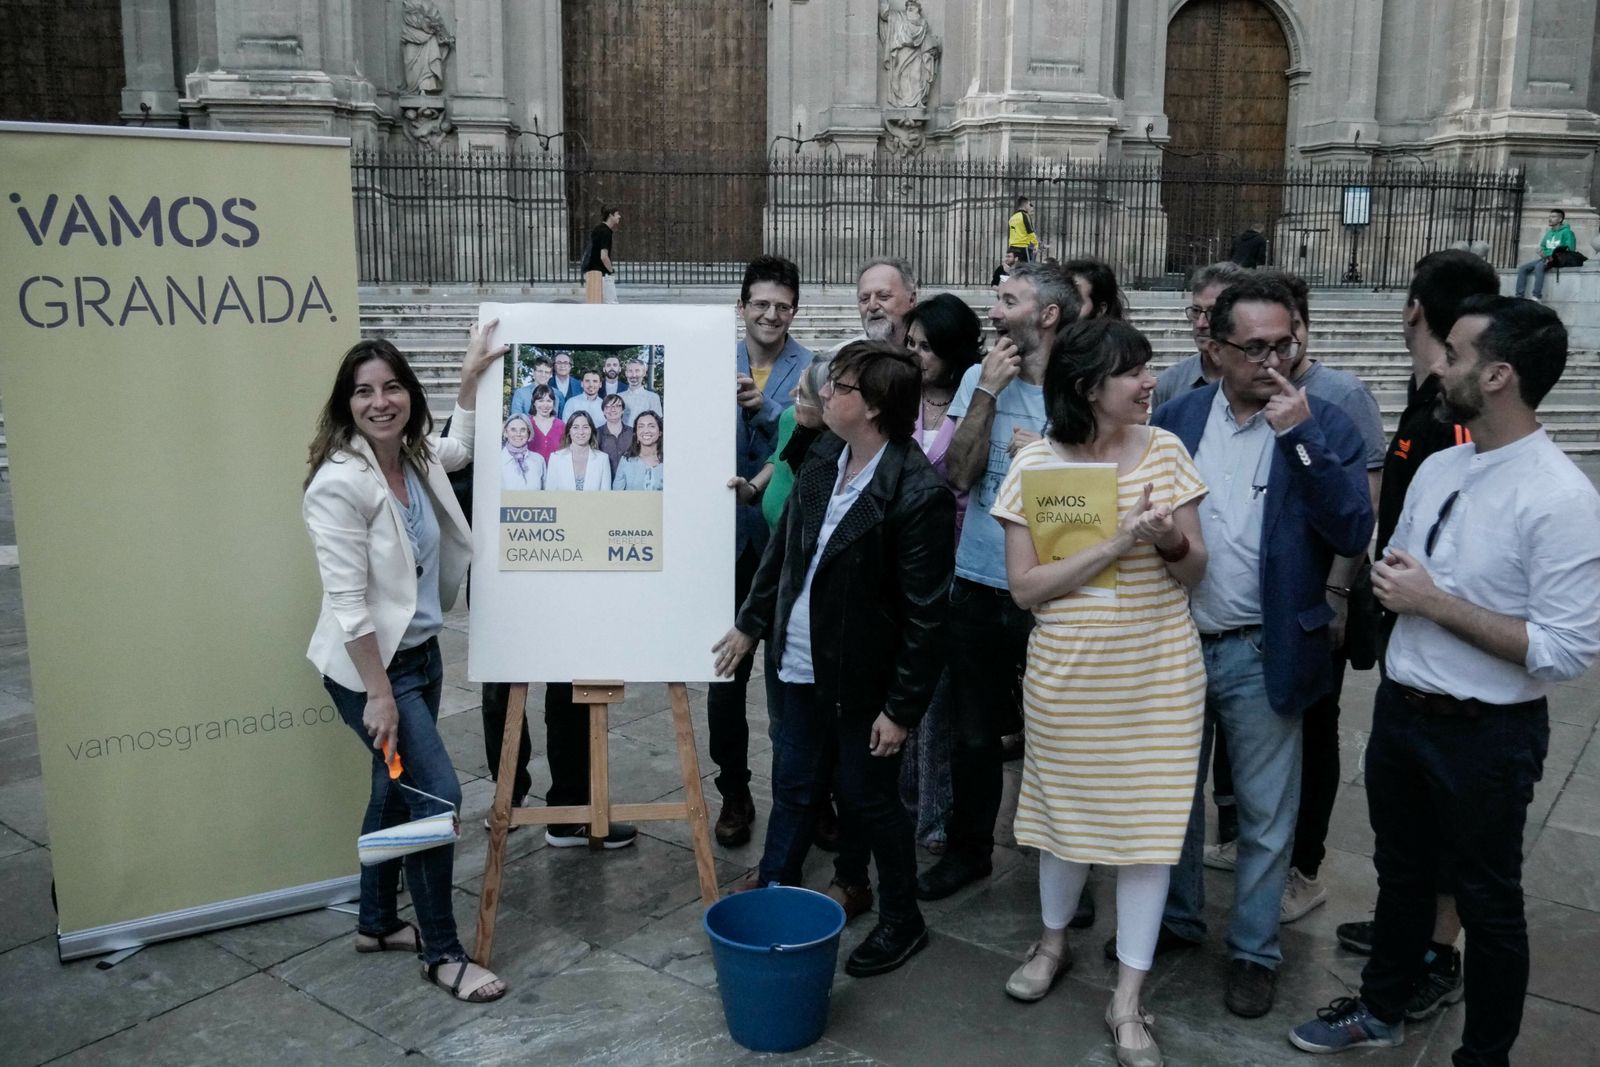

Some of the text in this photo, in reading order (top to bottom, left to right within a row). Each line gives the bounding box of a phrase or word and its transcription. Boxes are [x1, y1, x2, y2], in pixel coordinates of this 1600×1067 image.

[1035, 511, 1102, 525] GRANADA
[608, 529, 654, 537] GRANADA
[506, 548, 584, 562] GRANADA
[608, 544, 654, 561] MÁS
[66, 704, 341, 761] vamosgranada.co
